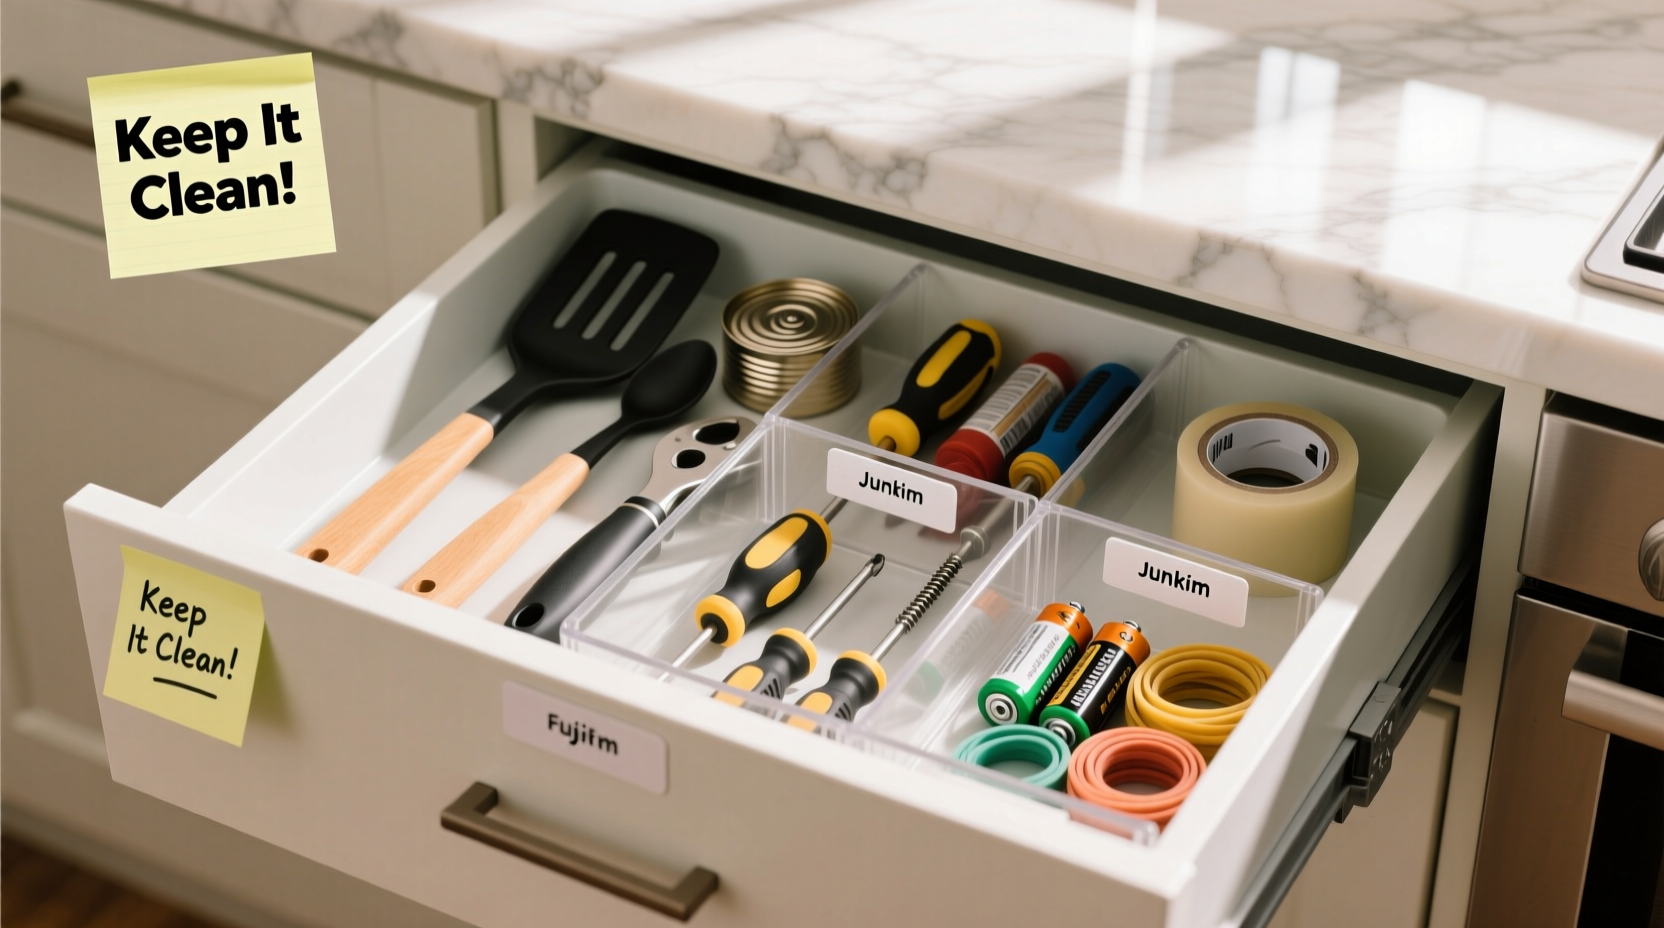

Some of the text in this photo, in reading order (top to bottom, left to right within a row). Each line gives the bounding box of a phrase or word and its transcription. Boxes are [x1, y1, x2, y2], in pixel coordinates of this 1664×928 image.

[114, 102, 303, 164] Keep It
[130, 160, 297, 221] Clean!
[858, 471, 924, 506] Junkim
[140, 579, 207, 638] Keep
[1137, 561, 1211, 599] Junkim
[127, 623, 239, 680] It Clean!
